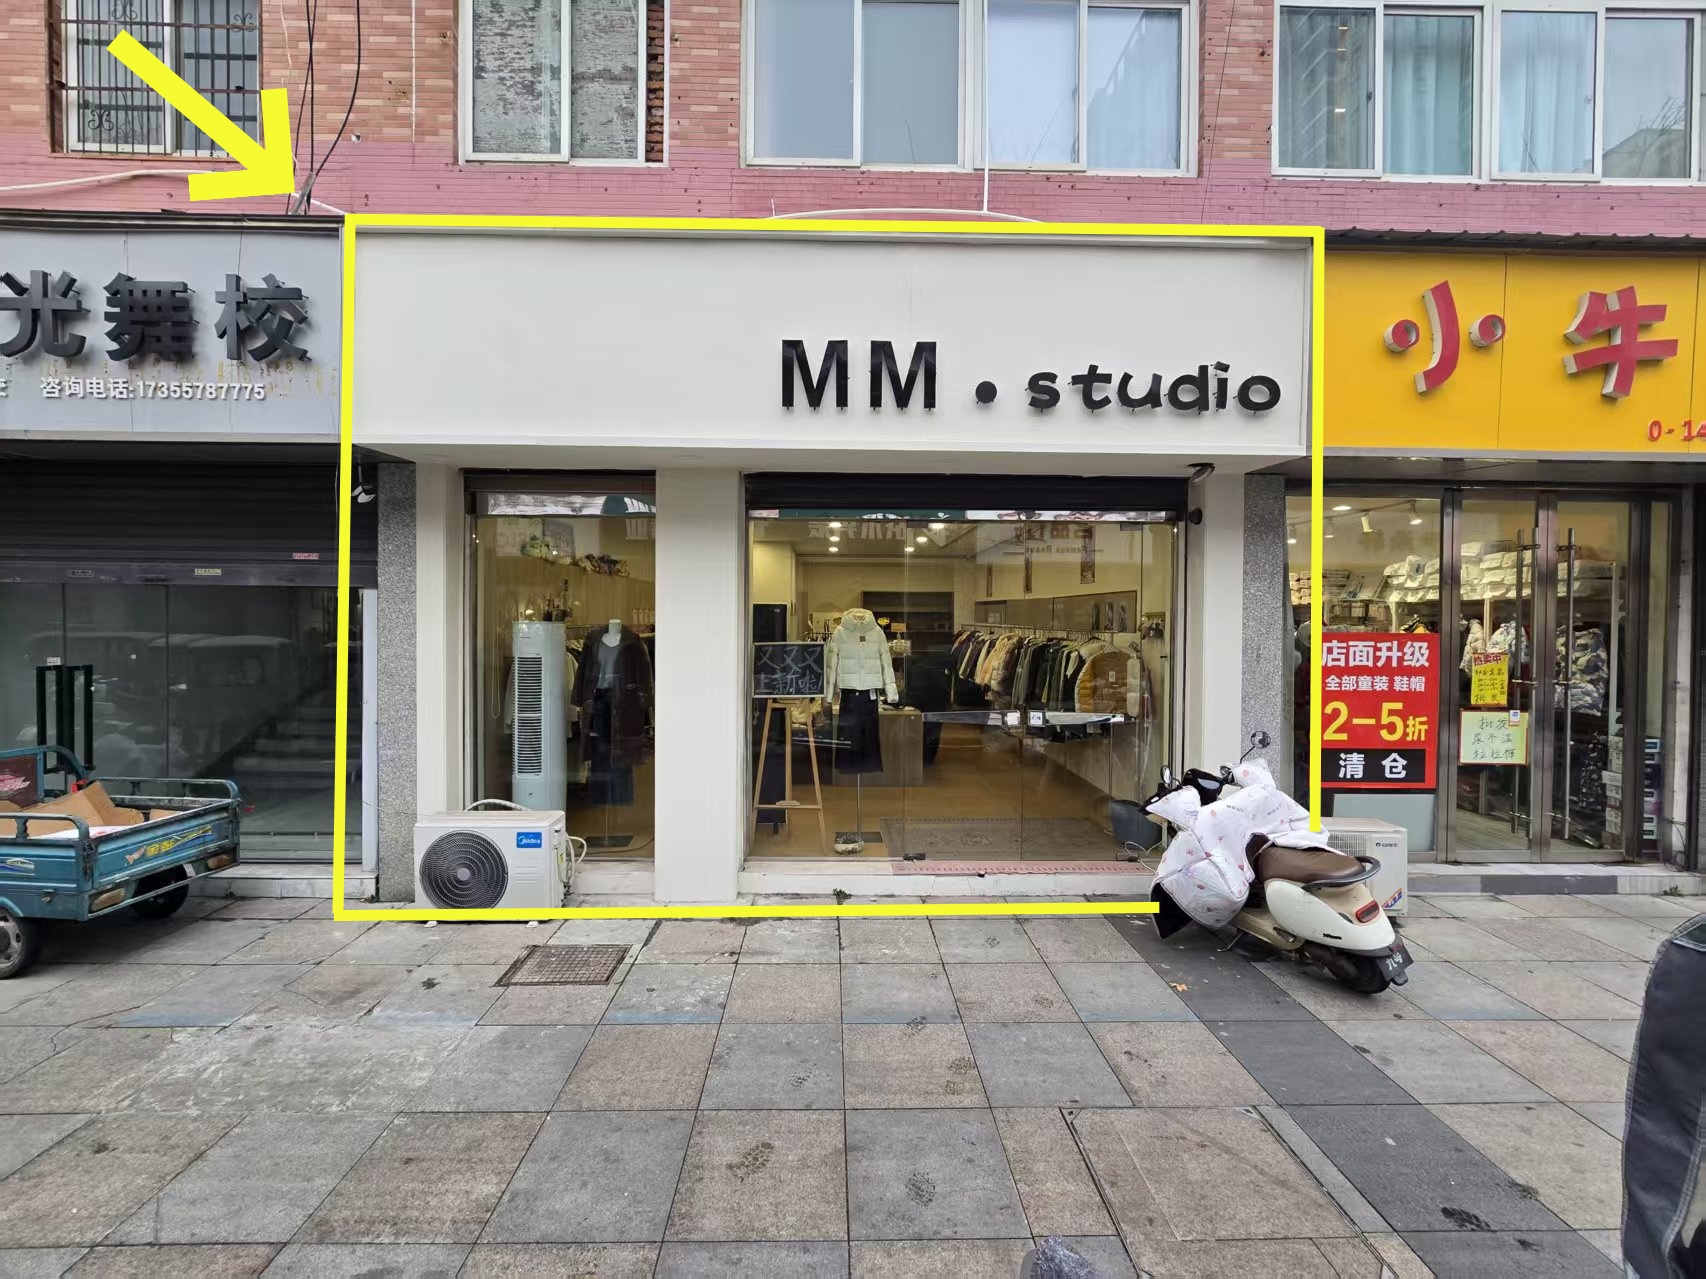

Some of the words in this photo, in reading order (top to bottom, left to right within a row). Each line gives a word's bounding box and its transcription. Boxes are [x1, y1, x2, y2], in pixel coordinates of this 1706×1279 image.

[0, 269, 312, 362] 光舞校
[781, 339, 937, 409] MM
[1026, 361, 1281, 412] studio
[1322, 640, 1429, 667] 店面升级
[1325, 675, 1388, 691] 全部童装
[1394, 676, 1425, 692] 鞋帽
[1339, 752, 1407, 779] 清仓
